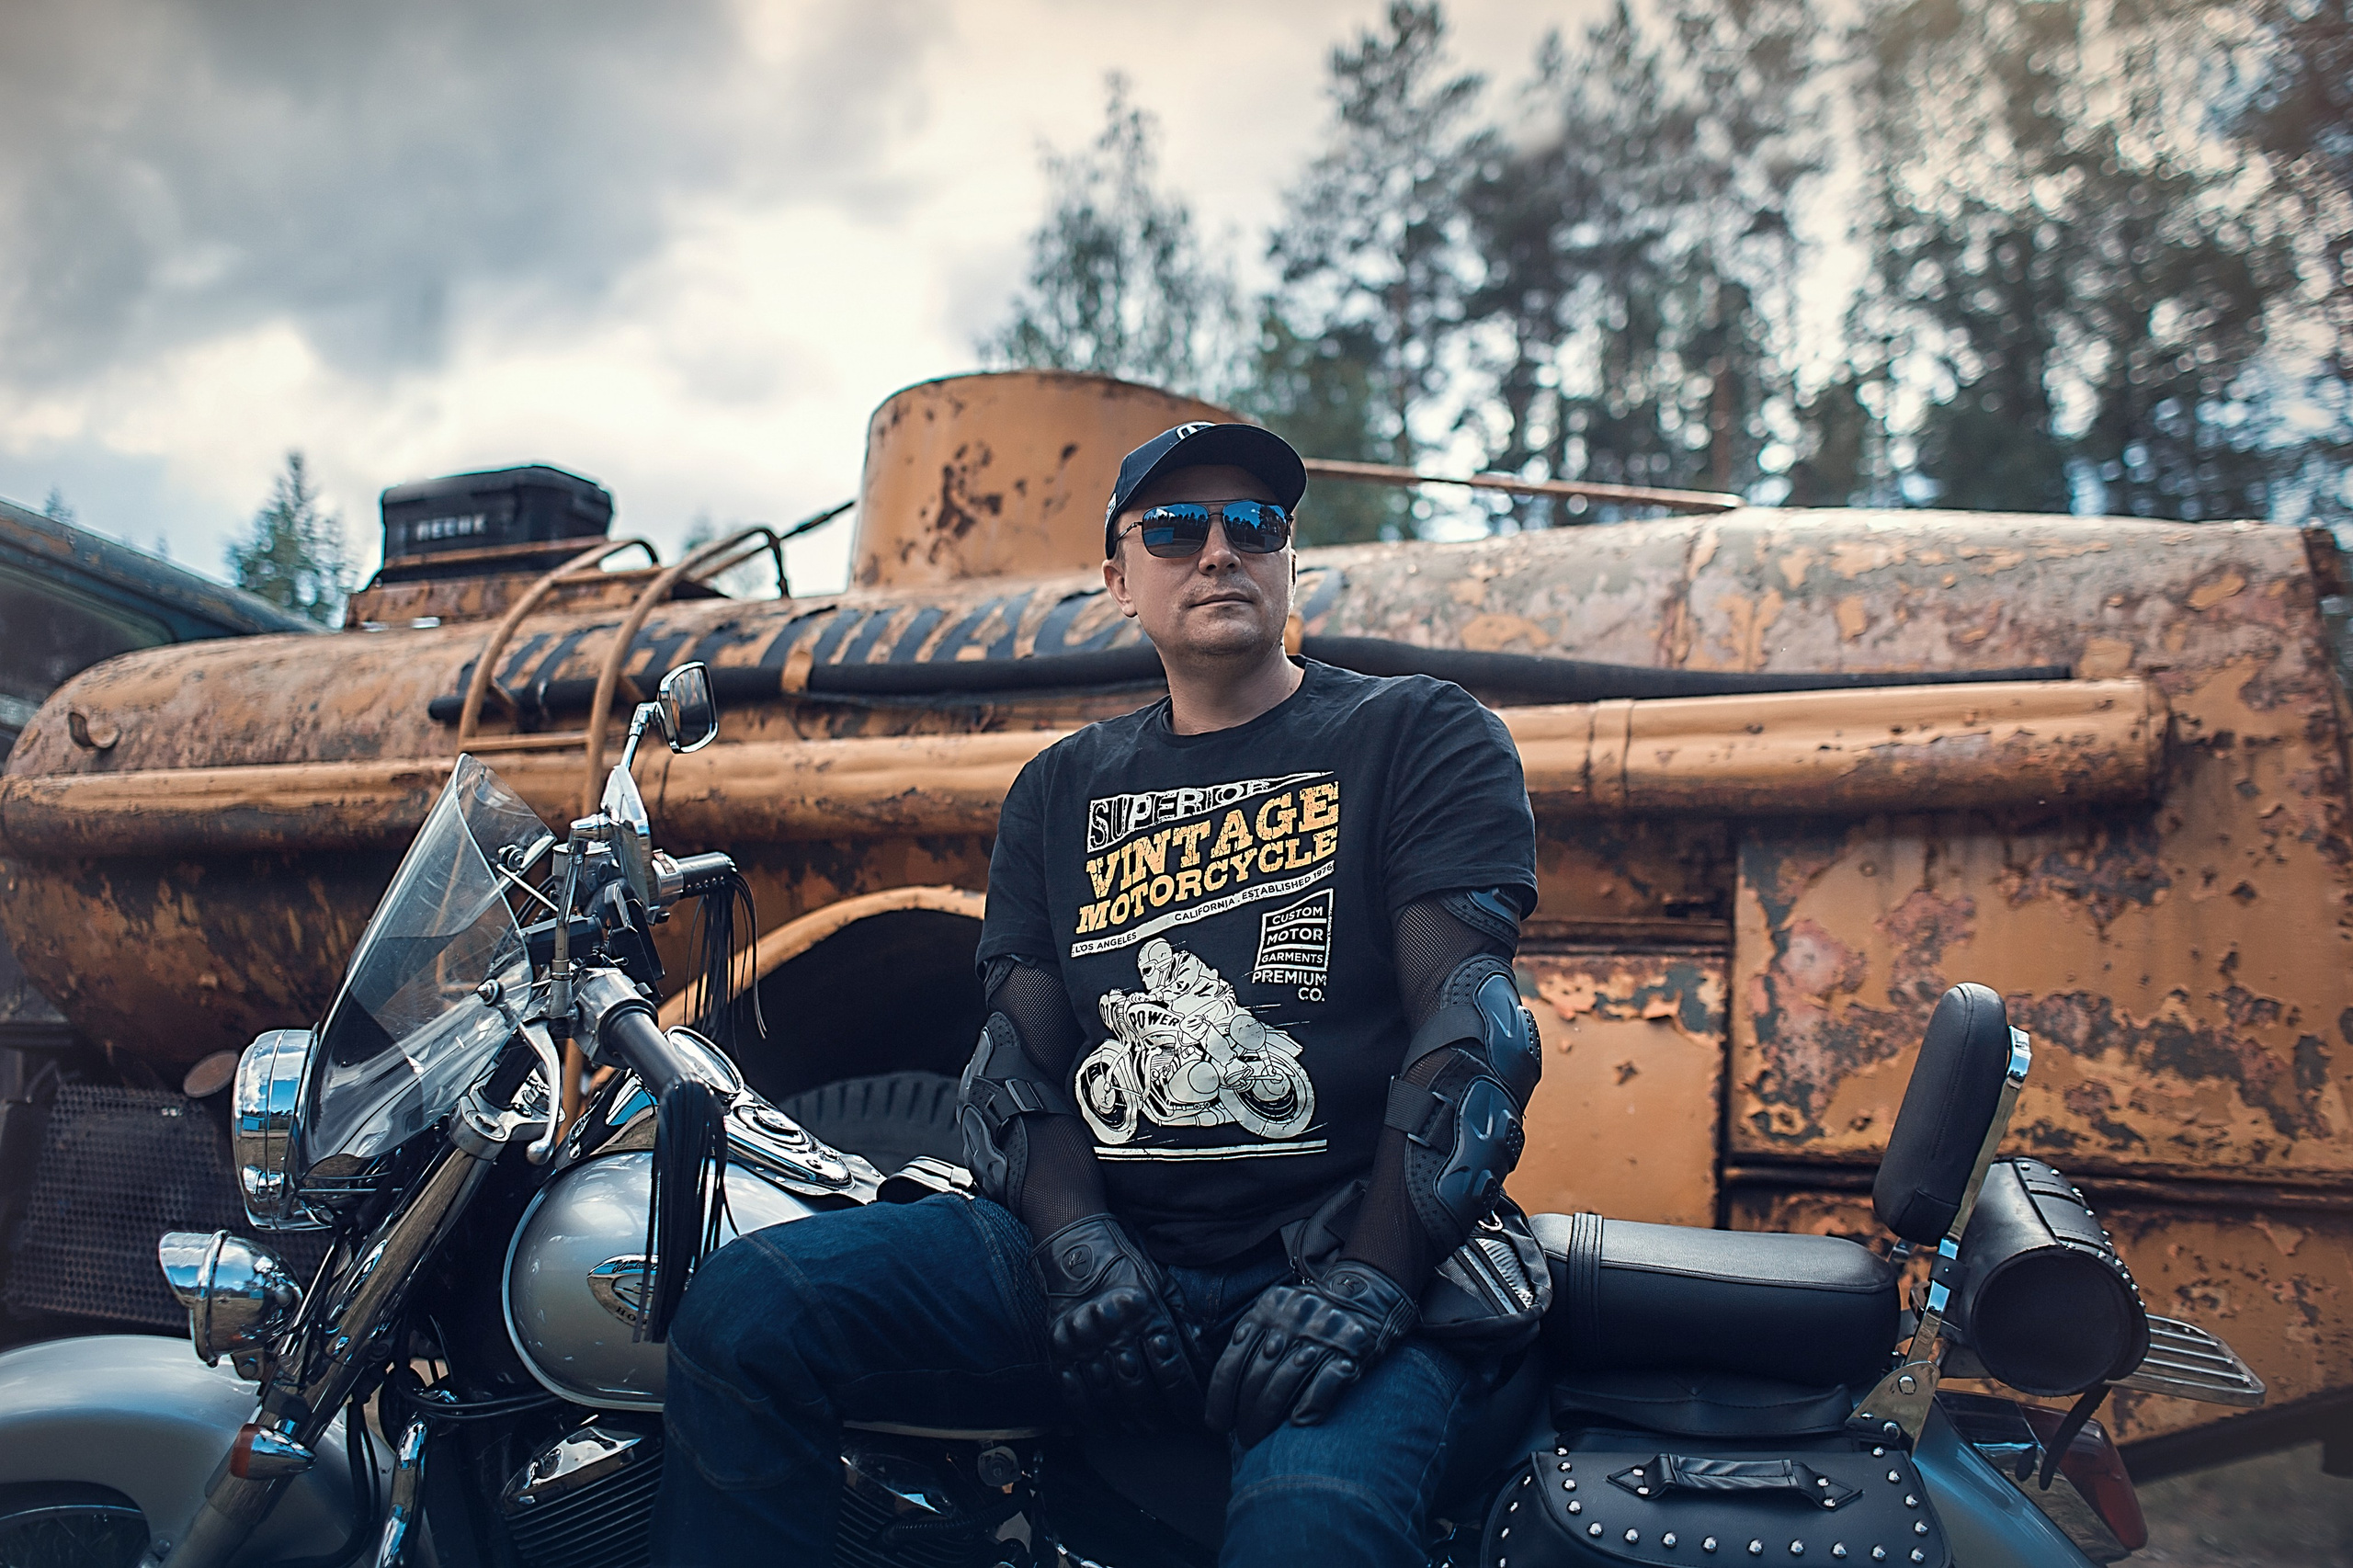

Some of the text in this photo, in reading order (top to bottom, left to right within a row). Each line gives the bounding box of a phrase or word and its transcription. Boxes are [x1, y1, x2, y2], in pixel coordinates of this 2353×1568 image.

[1088, 780, 1270, 851] SUPERIOR
[1086, 781, 1339, 899] VINTAGE
[1075, 825, 1338, 934] MOTORCYCLE
[1074, 865, 1333, 953] LOS ANGELES CALIFORNIA ESTABLISHED 1976
[1272, 905, 1324, 925] CUSTOM
[1266, 927, 1324, 946] MOTOR
[1261, 951, 1324, 963] GARMENTS
[1251, 969, 1327, 986] PREMIUM
[1297, 986, 1325, 1002] CO.
[1128, 1009, 1180, 1029] POWER
